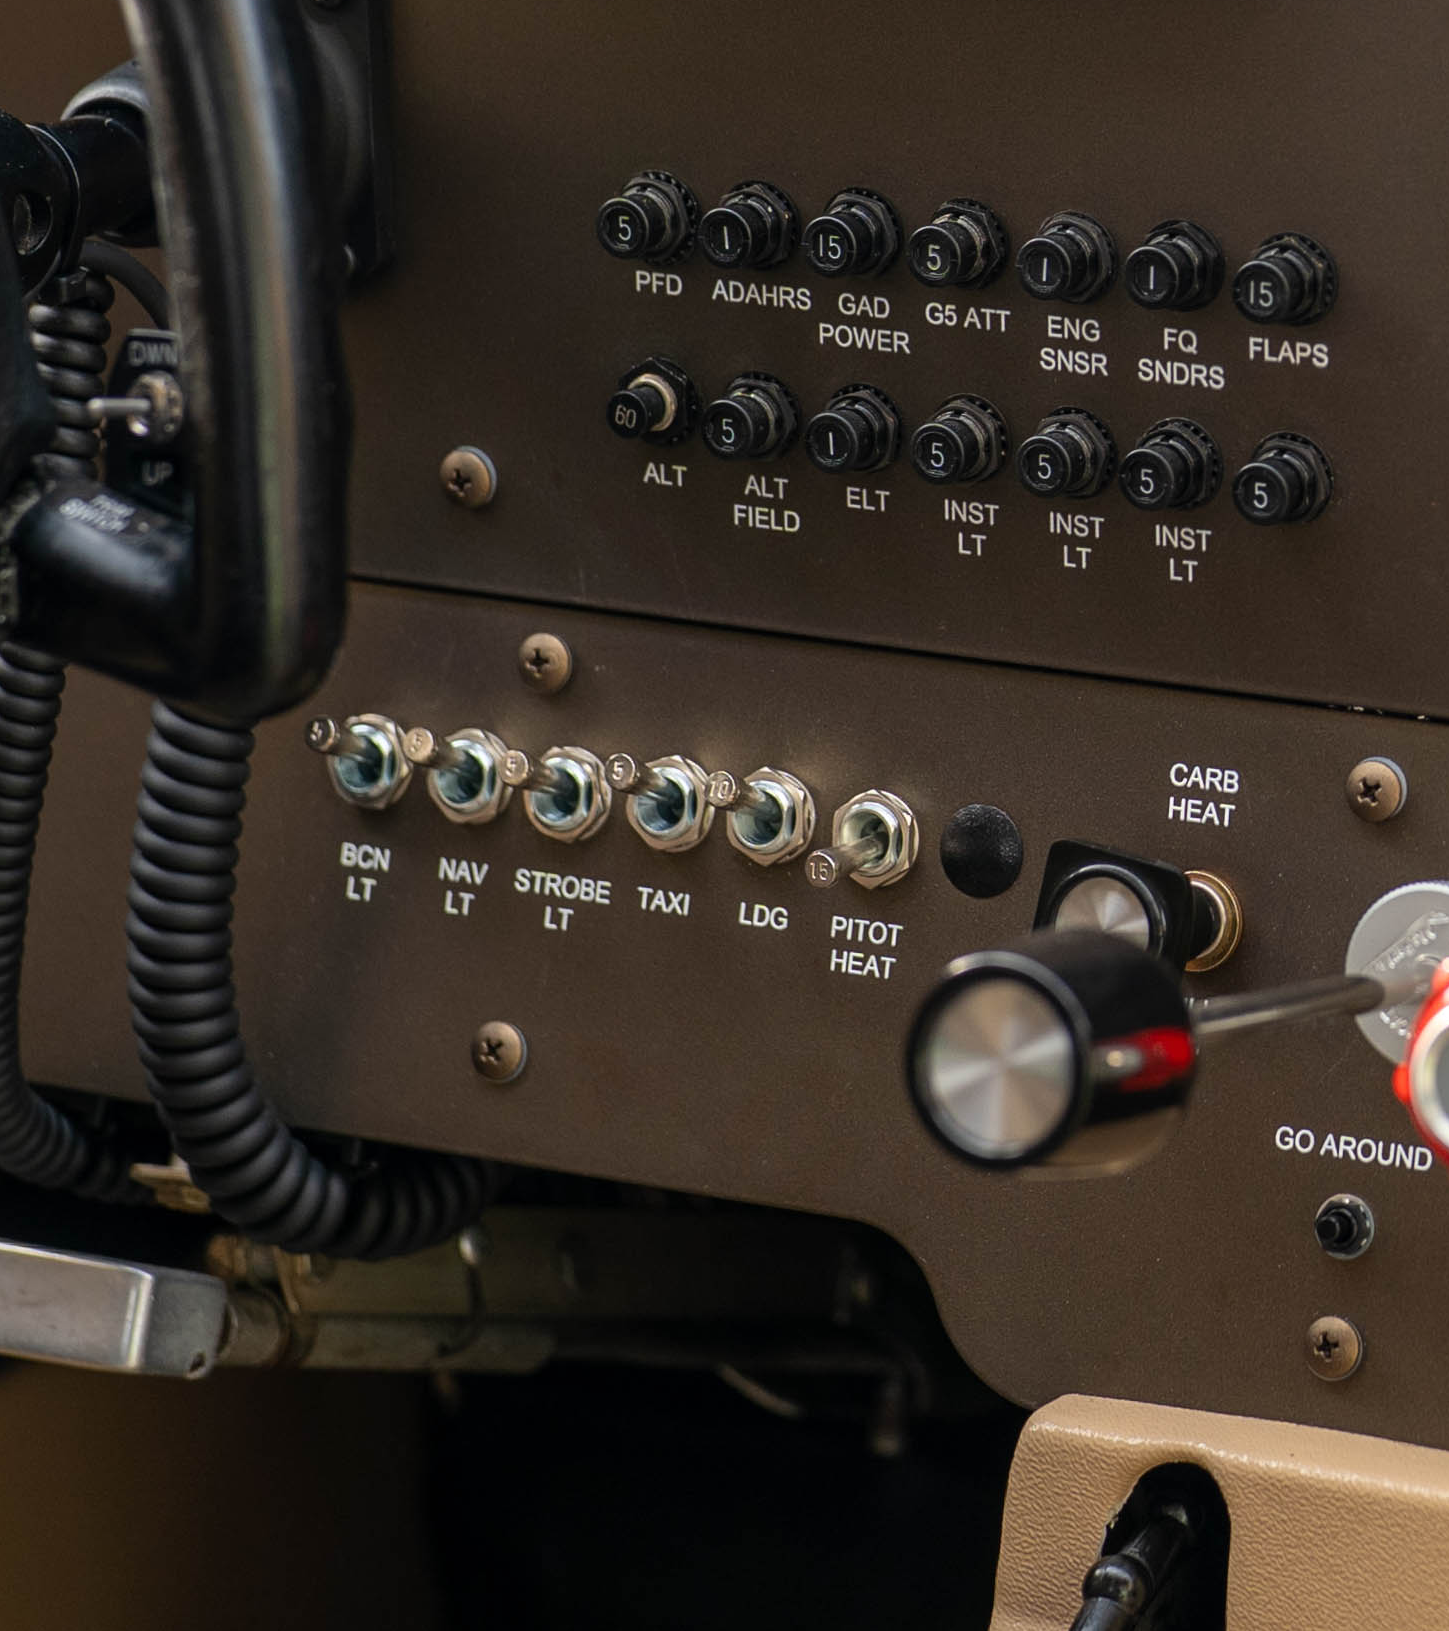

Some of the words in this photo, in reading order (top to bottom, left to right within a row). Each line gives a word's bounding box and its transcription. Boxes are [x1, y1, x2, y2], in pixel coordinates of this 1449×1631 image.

[635, 271, 683, 296] PFD
[712, 279, 812, 311] ADAHRS
[838, 293, 890, 318] GAD
[925, 302, 957, 326] G5
[963, 307, 1011, 332] ATT
[819, 323, 911, 354] POWER
[1047, 316, 1101, 342] ENG
[1163, 327, 1198, 355] FQ
[1040, 348, 1109, 377] SNSR
[1248, 337, 1329, 369] FLAPS
[1137, 358, 1226, 390] SNDRS
[642, 462, 687, 487] ALT
[744, 474, 789, 500] ALT
[846, 486, 890, 512] ELT
[943, 499, 999, 525] INST
[733, 504, 800, 533] FIELD
[1049, 511, 1105, 539] INST
[958, 532, 987, 556] LT
[1155, 524, 1212, 552] INST
[1063, 545, 1092, 569] LT
[1169, 558, 1198, 583] LT
[1169, 762, 1240, 794] CARB
[1167, 796, 1236, 828] HEAT
[340, 842, 391, 872] BCN
[438, 857, 488, 886] NAV
[346, 876, 377, 902] LT
[514, 868, 611, 906] STROBE
[444, 890, 476, 917] LT
[638, 887, 690, 917] TAXI
[738, 902, 789, 930] LDG
[543, 905, 574, 932] LT
[830, 915, 903, 947] PITOT
[829, 948, 897, 980] HEAT
[1275, 1126, 1315, 1153] GO
[1320, 1131, 1433, 1171] AROUND
